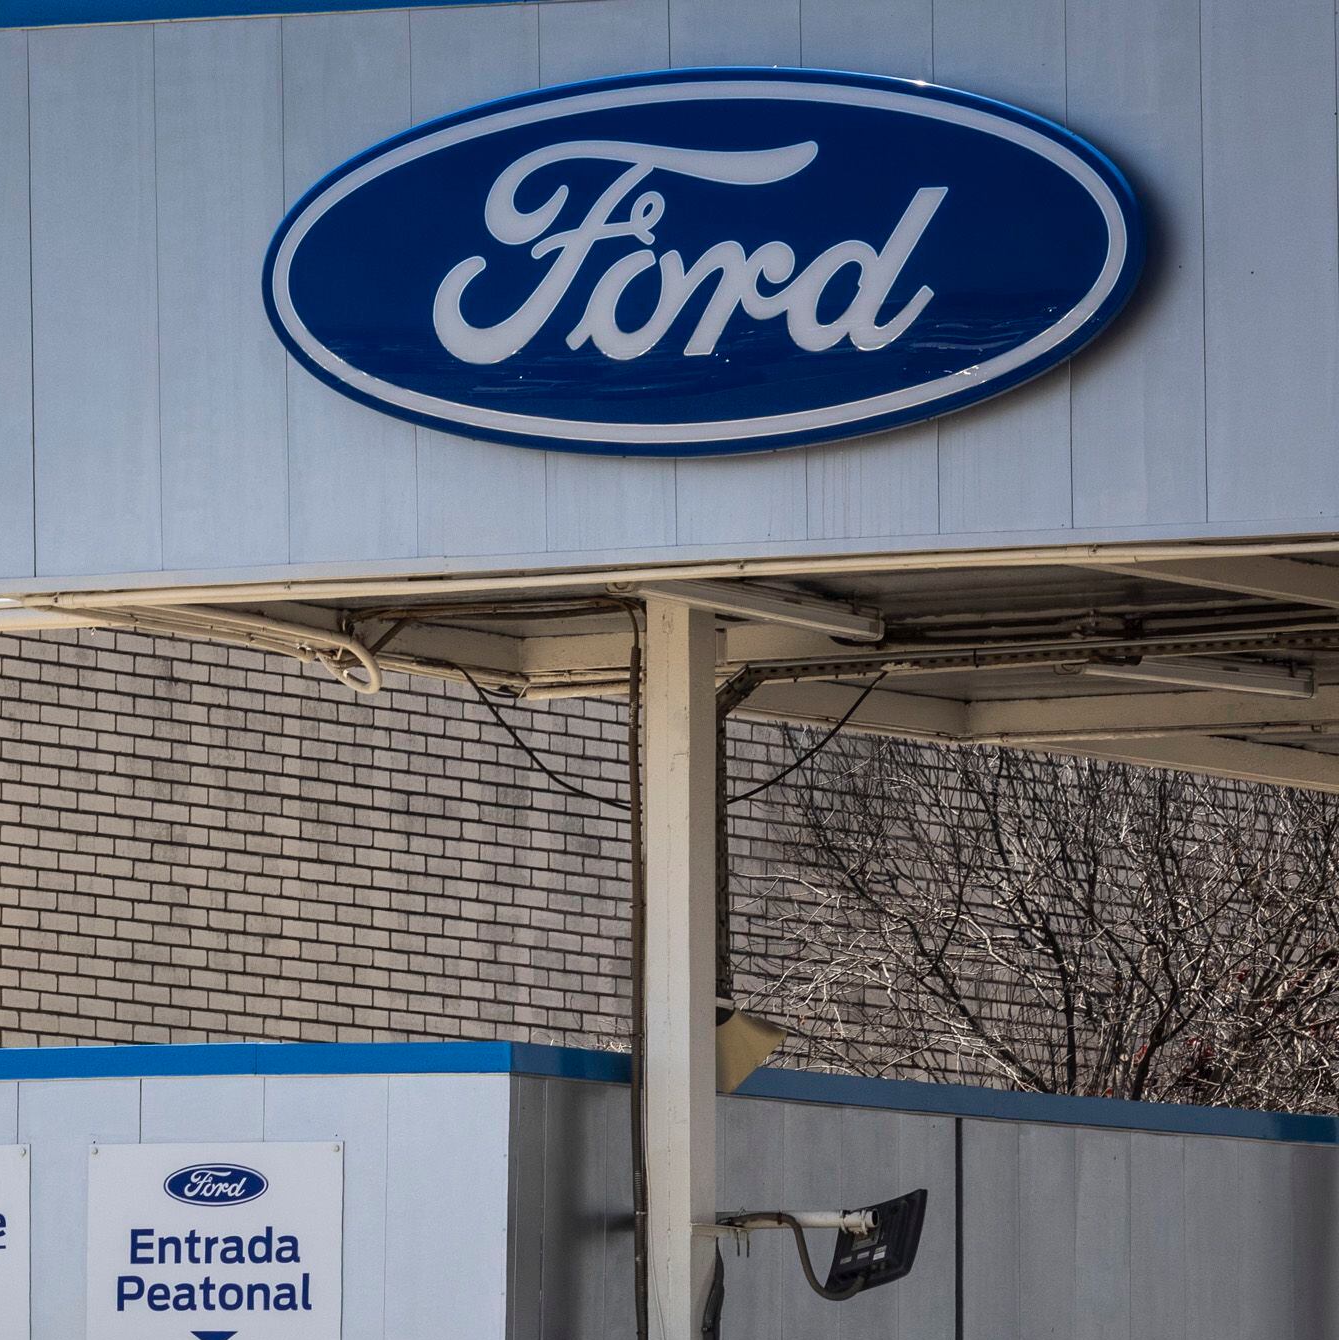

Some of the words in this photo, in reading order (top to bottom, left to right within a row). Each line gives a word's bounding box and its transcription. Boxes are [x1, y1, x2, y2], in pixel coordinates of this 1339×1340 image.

[433, 139, 949, 365] Ford
[183, 1167, 247, 1200] Ford
[130, 1225, 301, 1265] Entrada
[116, 1272, 312, 1312] Peatonal
